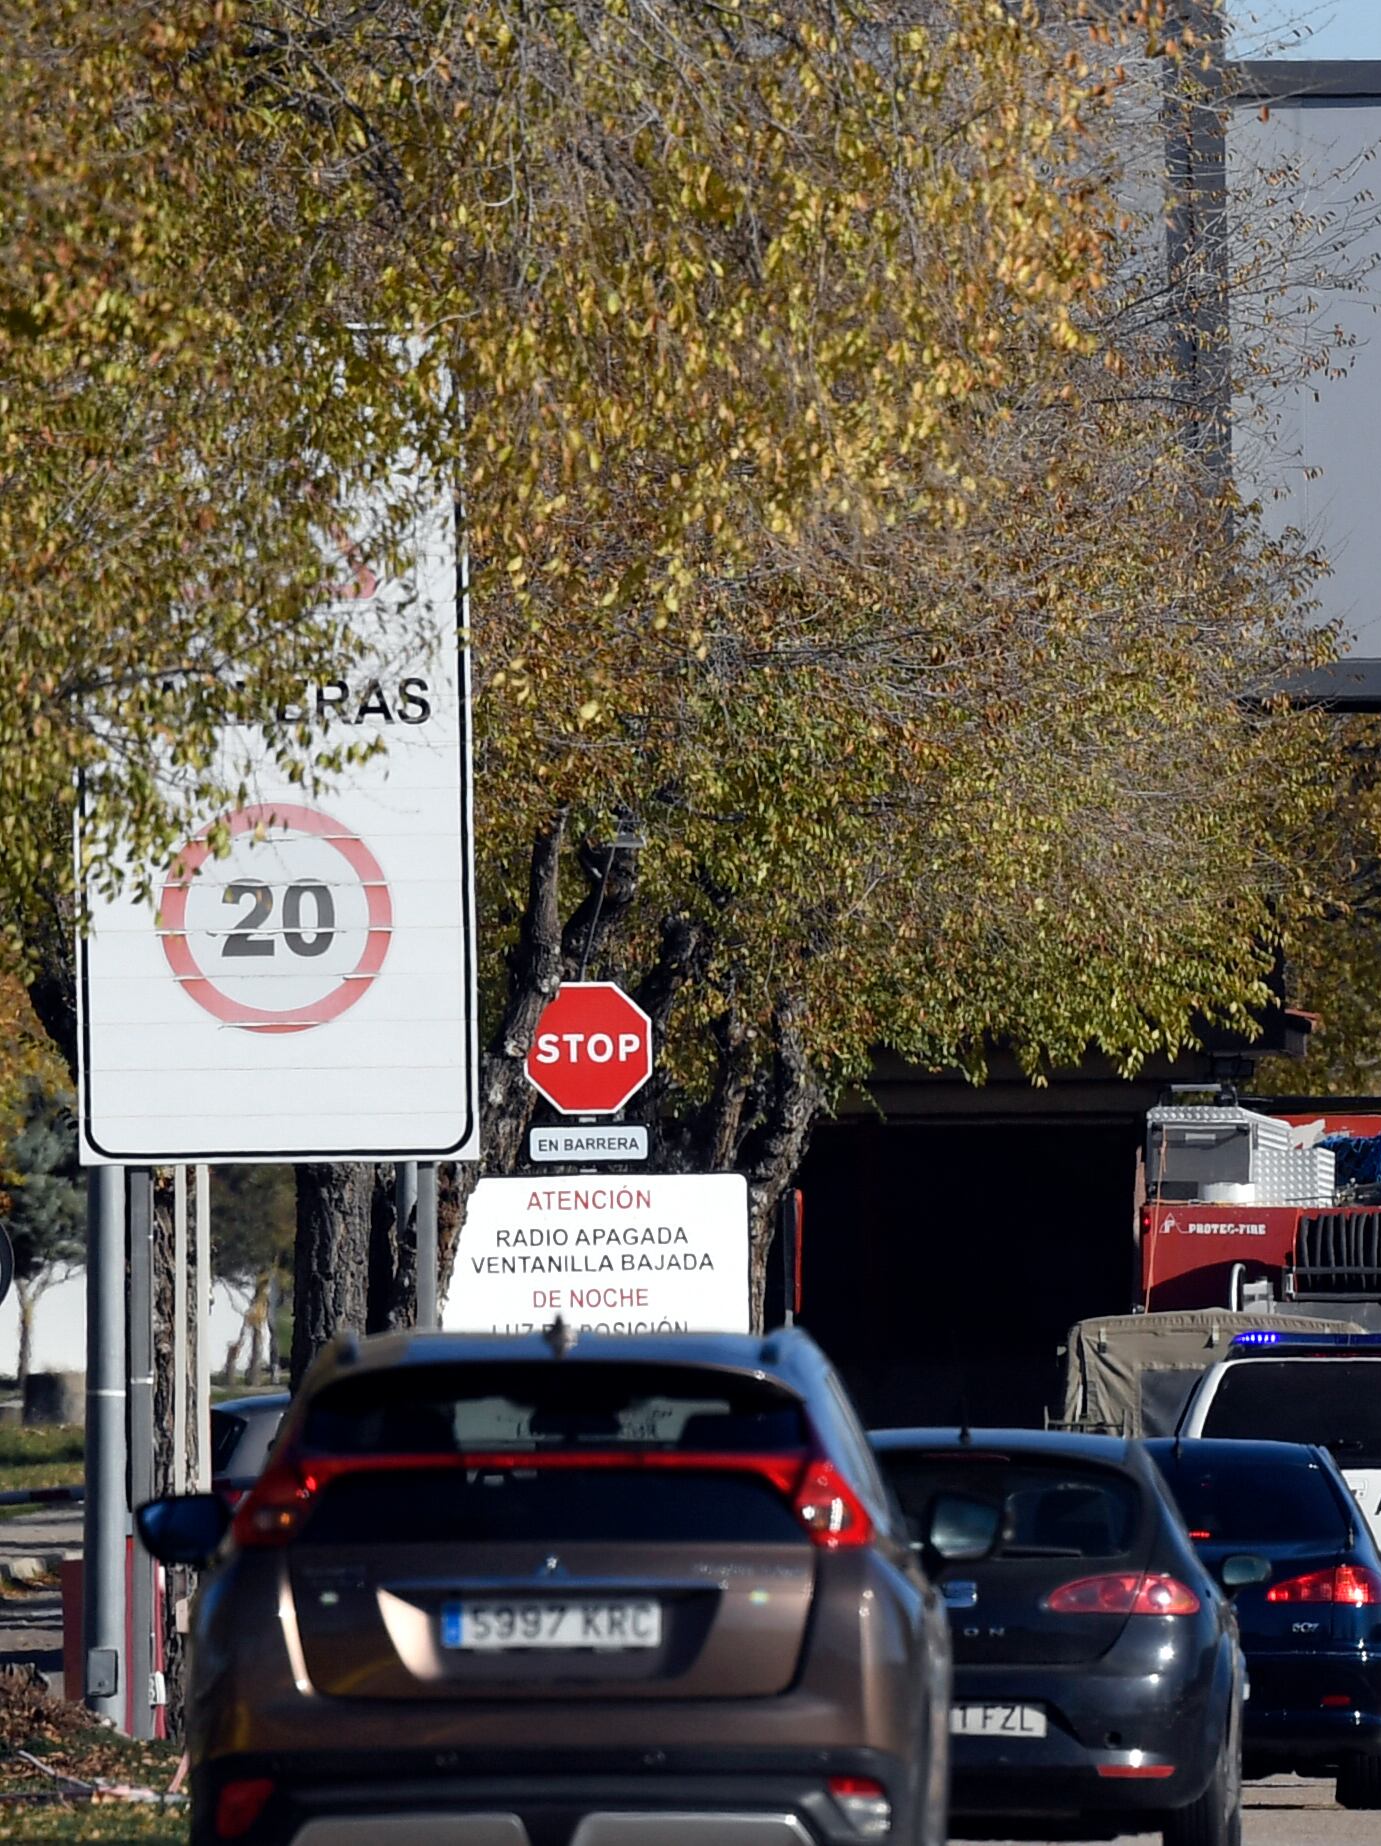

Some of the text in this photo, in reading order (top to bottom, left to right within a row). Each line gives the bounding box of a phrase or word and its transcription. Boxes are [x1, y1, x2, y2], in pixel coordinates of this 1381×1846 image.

[221, 877, 336, 958] 20
[536, 1033, 641, 1064] STOP
[538, 1137, 640, 1152] EN BARRERA
[526, 1185, 651, 1211] ATENCIÓN
[496, 1226, 689, 1248] RADIO APAGADA
[471, 1253, 715, 1274] VENTANILLA BAJADA
[533, 1288, 649, 1308] DE NOCHE
[582, 1605, 651, 1639] KRC
[981, 1703, 1034, 1731] FZL
